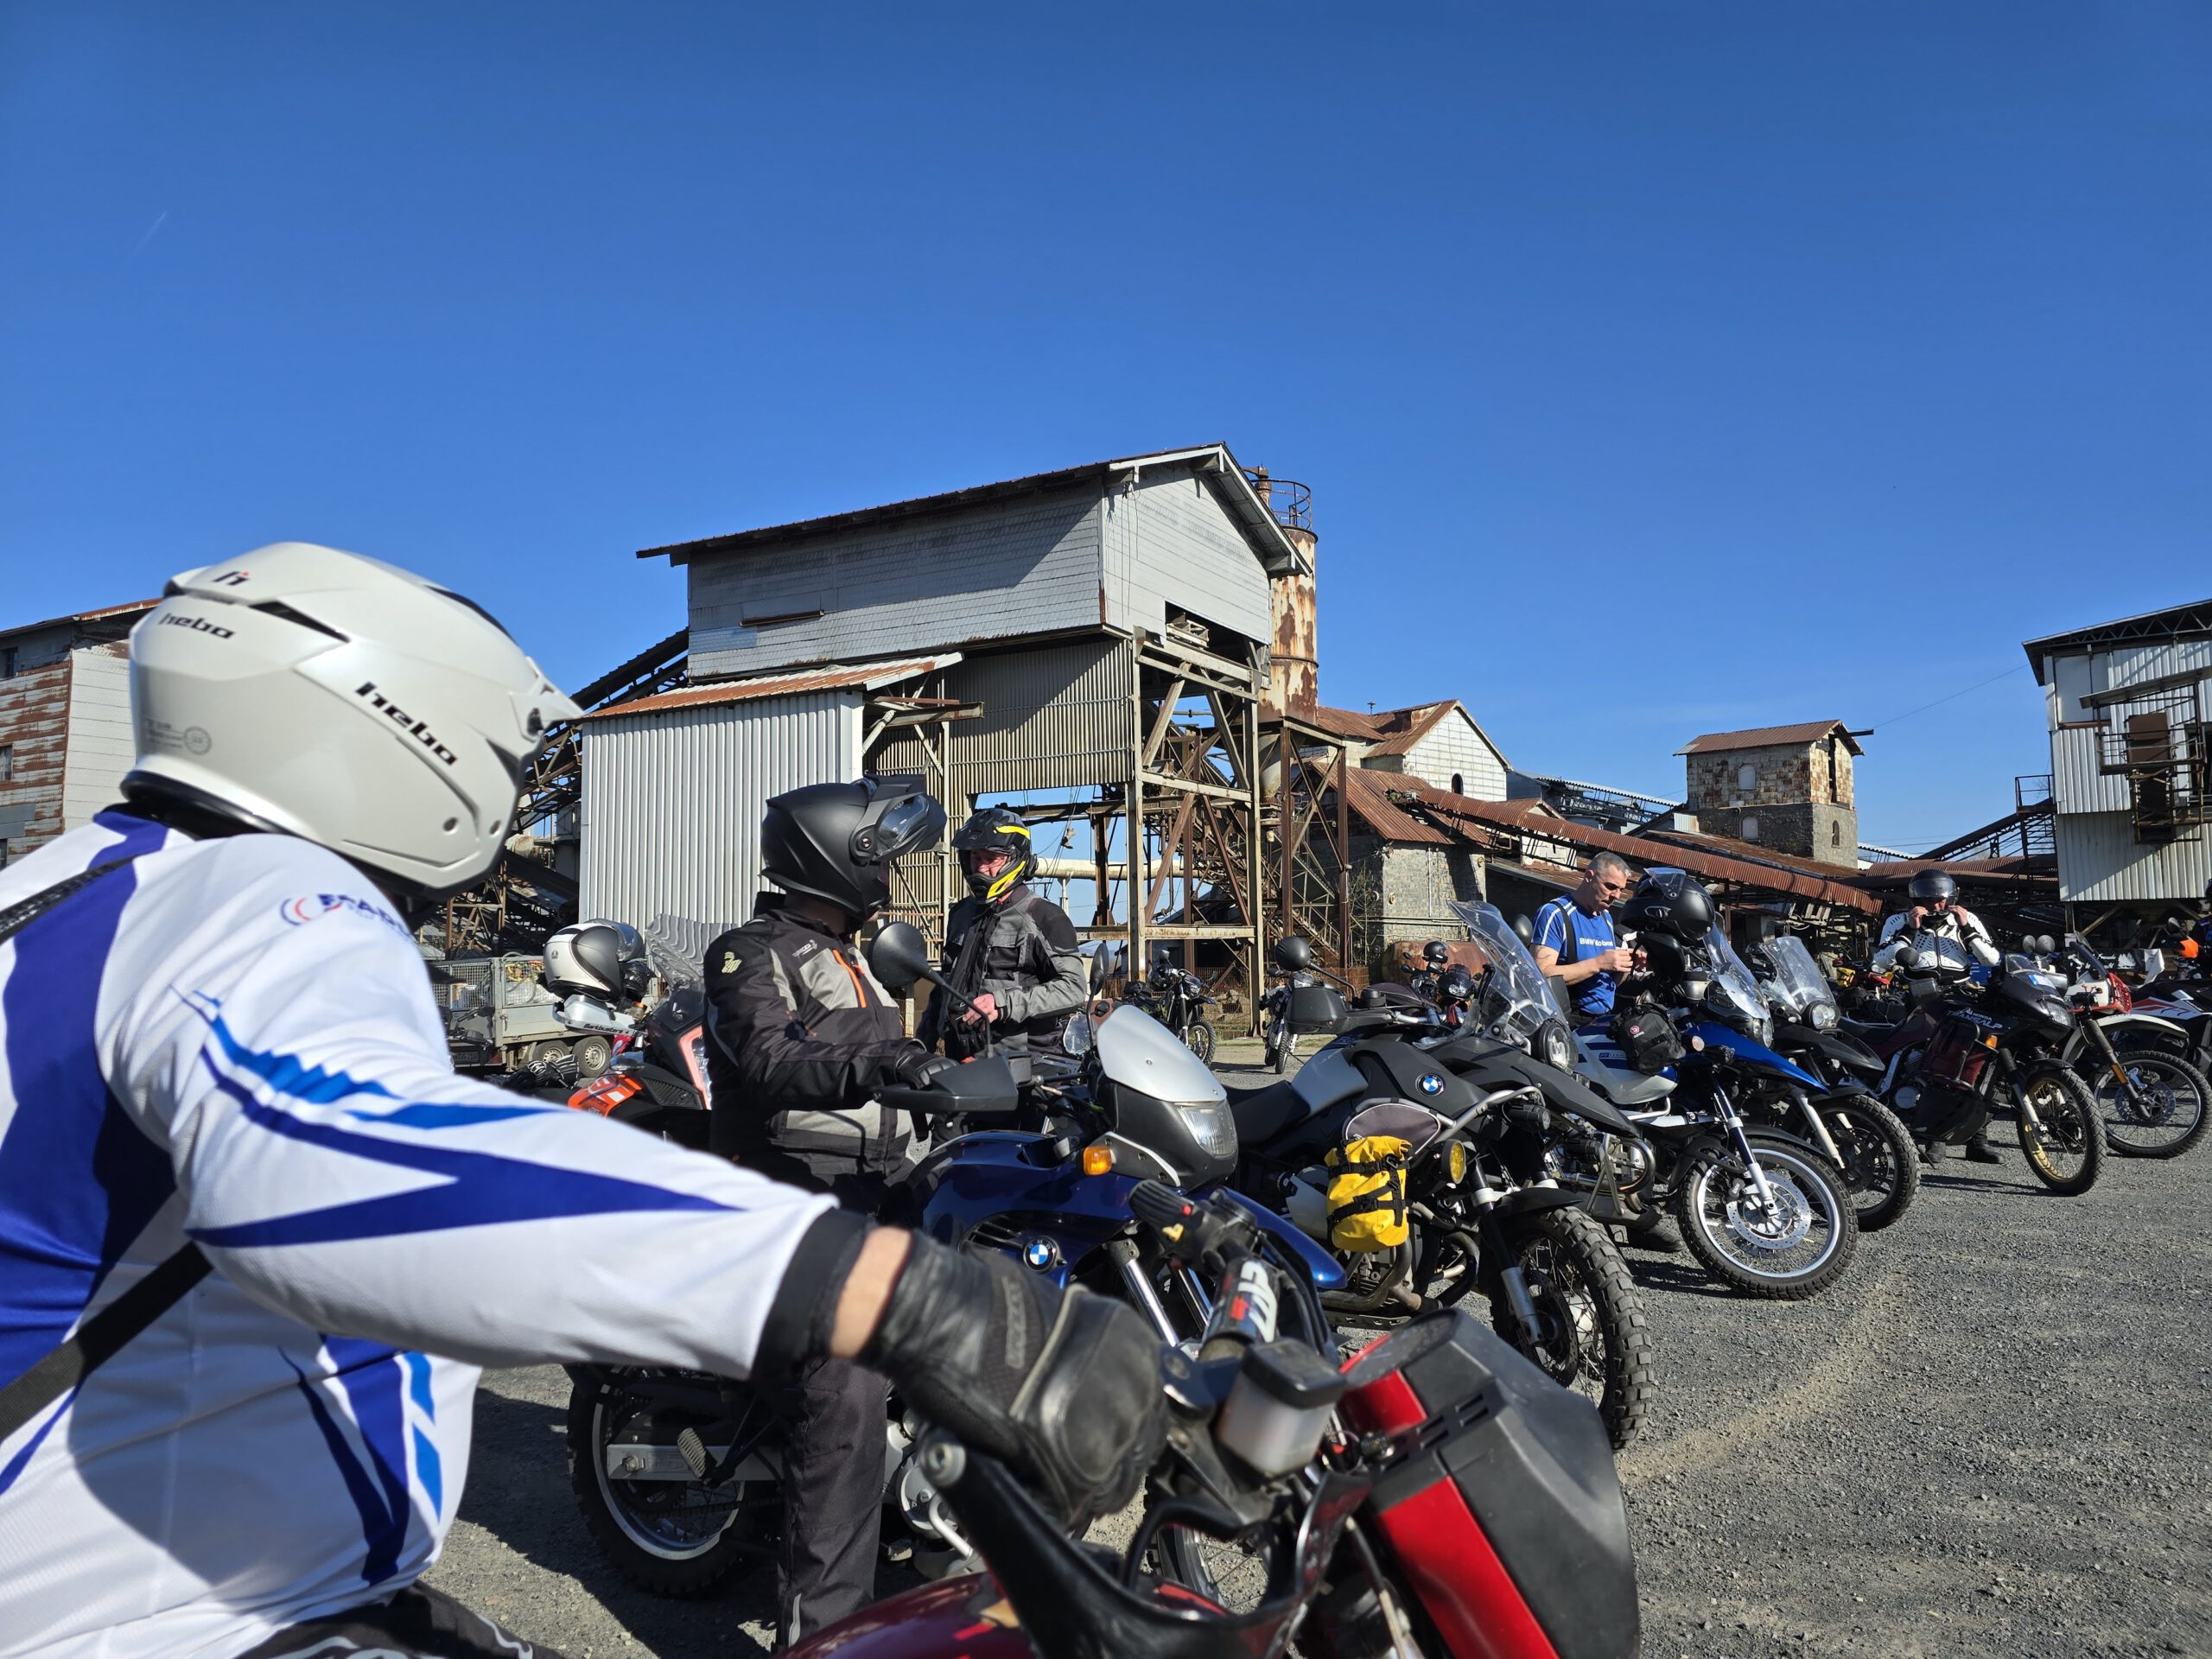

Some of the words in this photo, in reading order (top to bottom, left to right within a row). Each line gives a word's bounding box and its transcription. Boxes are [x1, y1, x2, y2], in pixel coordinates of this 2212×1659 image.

[159, 613, 234, 639] hebo
[355, 682, 457, 766] hebo
[1945, 1009, 2003, 1029] TRANSALP
